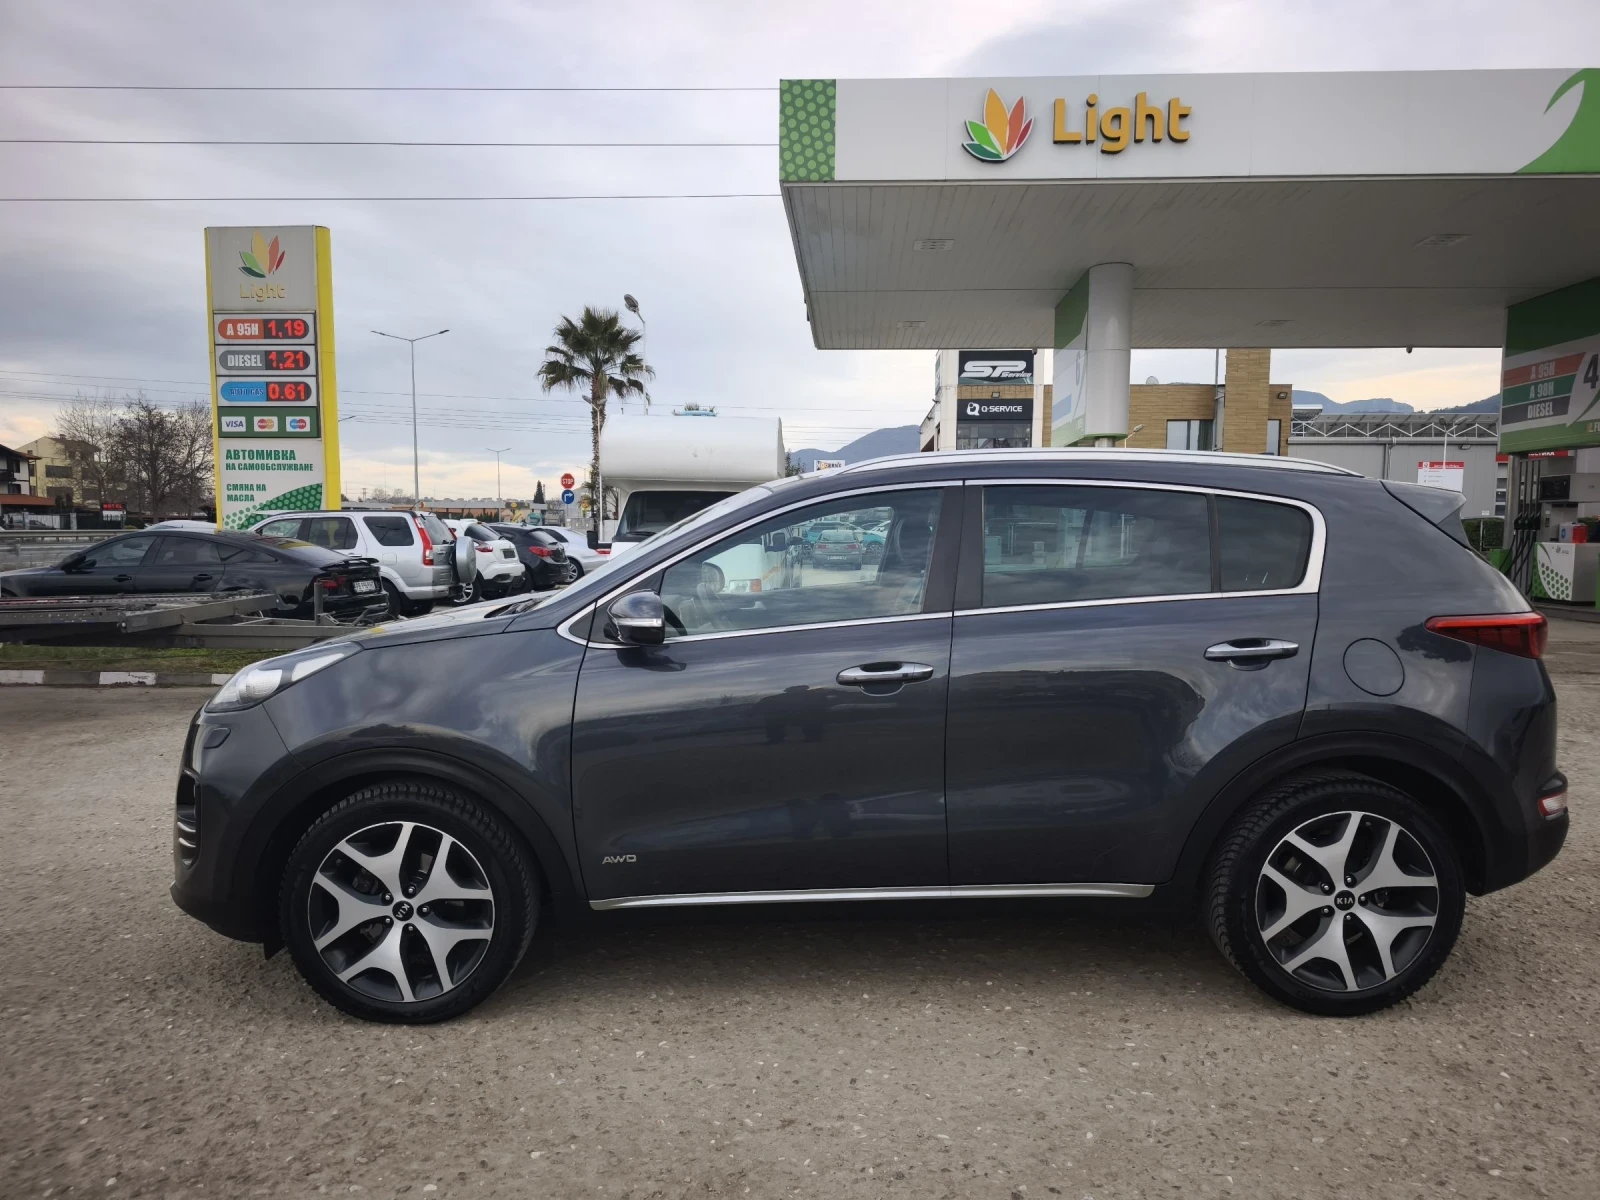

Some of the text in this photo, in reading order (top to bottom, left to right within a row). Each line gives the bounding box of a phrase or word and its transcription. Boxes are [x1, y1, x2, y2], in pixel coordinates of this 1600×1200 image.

[1053, 91, 1192, 153] Light
[240, 283, 286, 302] Light
[227, 354, 263, 367] DIESEL
[1583, 353, 1599, 389] 4
[1527, 401, 1554, 419] DIESEL
[225, 420, 244, 428] VISA
[225, 449, 297, 461] АВТОМИВКА
[225, 463, 314, 472] НА САМООБСЛУЖВАНЕ
[226, 483, 267, 492] СМЯНА НА
[226, 494, 255, 502] МАСЛА
[601, 854, 637, 865] AWD
[1336, 897, 1354, 905] KIA
[395, 903, 410, 919] KIA
